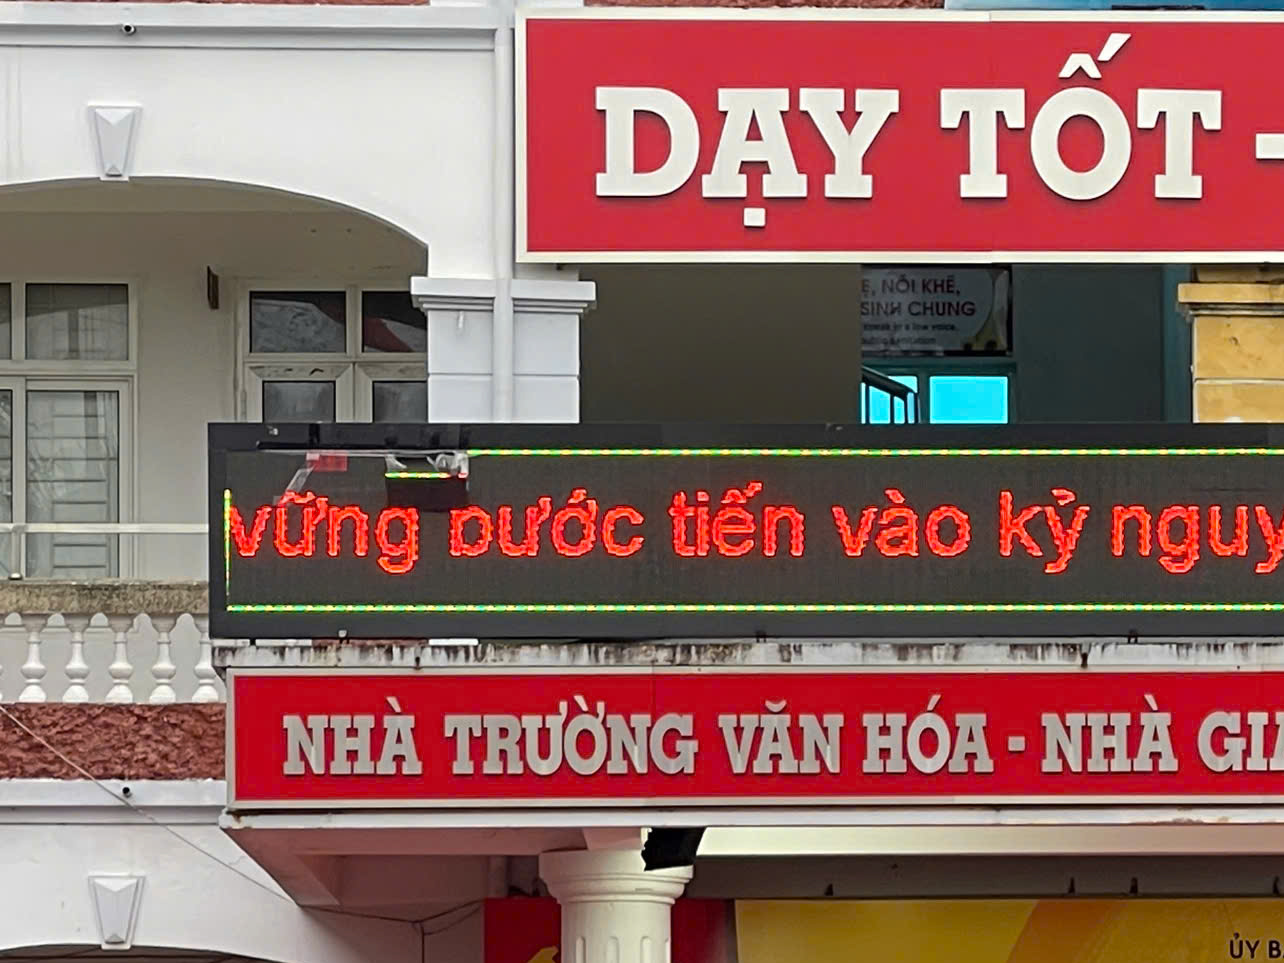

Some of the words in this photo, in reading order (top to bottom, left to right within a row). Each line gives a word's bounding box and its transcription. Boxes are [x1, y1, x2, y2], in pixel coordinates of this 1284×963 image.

[596, 87, 901, 229] DẠY
[941, 33, 1223, 202] TỐT
[907, 301, 976, 316] CHUNG
[232, 489, 420, 575] vững
[669, 483, 806, 558] tiến
[833, 489, 972, 557] vào
[1000, 488, 1090, 575] kỷ
[282, 696, 423, 777] NHÀ
[444, 694, 699, 777] TRƯỜNG
[719, 700, 845, 774] VĂN
[863, 694, 995, 775] HÓA
[1042, 694, 1179, 774] NHÀ
[1229, 932, 1261, 959] ỦY
